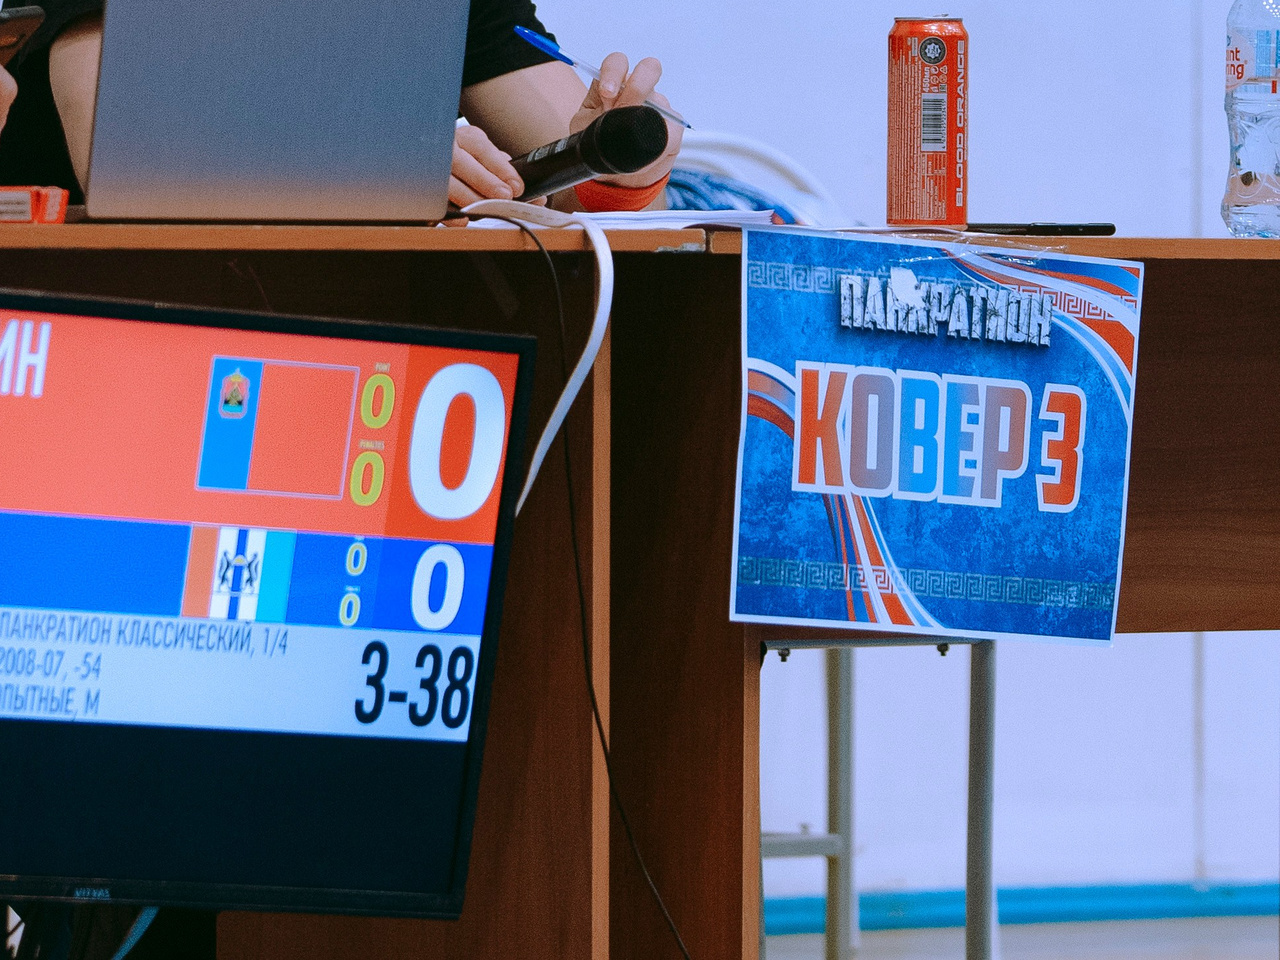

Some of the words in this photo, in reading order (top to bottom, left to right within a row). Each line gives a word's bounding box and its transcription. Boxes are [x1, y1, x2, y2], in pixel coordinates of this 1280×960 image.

[956, 40, 965, 128] ORANGE
[956, 133, 965, 207] BLOOD
[360, 373, 396, 429] 0
[408, 362, 506, 521] 0
[792, 361, 1032, 507] КОВЕР
[1035, 383, 1087, 513] 3
[349, 451, 385, 506] 0
[346, 542, 368, 576] 0
[410, 543, 466, 631] 0
[0, 611, 112, 645] ПАНКРАТИОН
[116, 616, 256, 659] КЛАССИЧЕСКИЙ,
[263, 626, 290, 657] 1/4
[339, 592, 361, 627] 0
[73, 651, 103, 680] -54
[354, 640, 476, 730] 3-38
[83, 687, 102, 716] М
